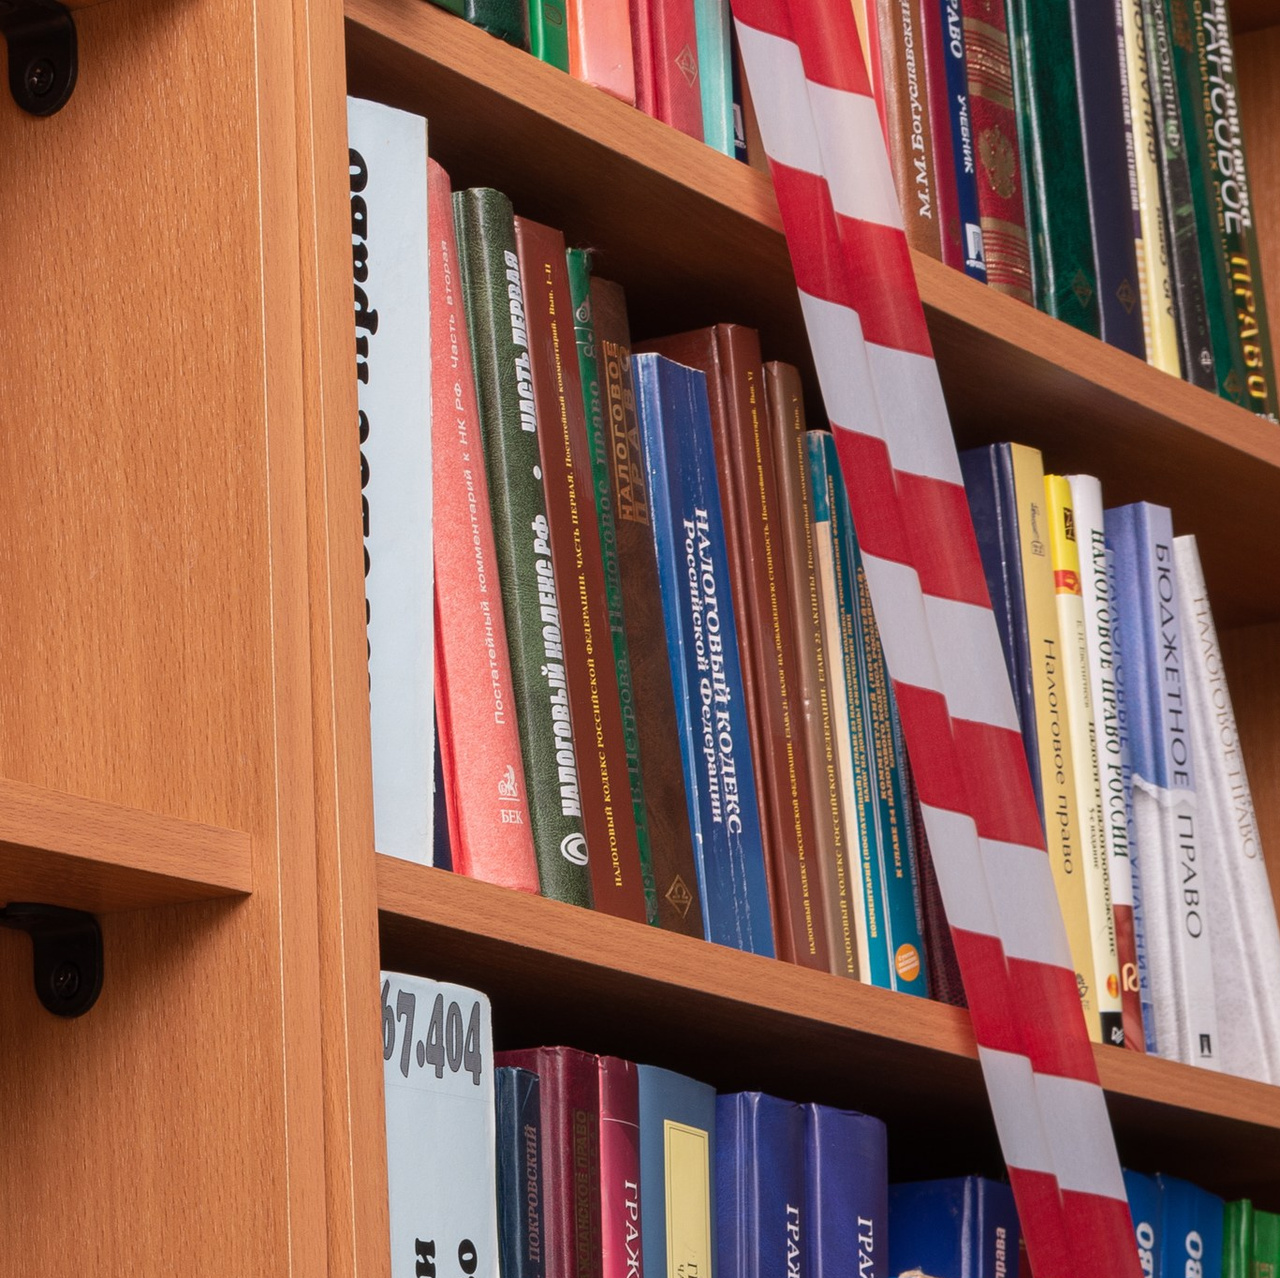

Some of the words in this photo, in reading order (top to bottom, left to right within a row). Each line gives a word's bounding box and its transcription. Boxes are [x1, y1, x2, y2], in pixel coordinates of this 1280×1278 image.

[956, 94, 973, 173] УЧЕБНИК
[441, 240, 454, 306] вторая
[502, 249, 527, 346] ПЕРВАЯ
[443, 314, 459, 369] Часть
[1230, 256, 1268, 399] ПРАВО
[453, 378, 465, 412] РФ.
[456, 417, 468, 445] НК
[514, 352, 537, 433] ЧАСТЬ
[559, 396, 573, 468] Постатейный
[586, 378, 607, 466] право
[604, 341, 635, 520] НАЛОГОВОЕ
[618, 345, 647, 525] ПРАВО
[459, 452, 470, 462] к
[567, 471, 579, 525] ПЕРВАЯ.
[461, 469, 487, 593] комментарий
[530, 514, 552, 557] РФ
[573, 528, 584, 569] ЧАСТЬ
[535, 559, 563, 660] КОДЕКС
[578, 572, 593, 655] ФЕДЕРАЦИИ.
[1091, 528, 1114, 669] НАЛОГОВОЕ
[476, 600, 506, 725] Постатейный
[586, 658, 605, 748] РОССИЙСКОЙ
[682, 518, 710, 672] Российской
[699, 677, 726, 824] Федерации
[693, 507, 732, 705] НАЛОГОВЫЙ
[715, 709, 742, 835] КОДЕКС
[542, 662, 582, 818] НАЛОГОВЫЙ
[1043, 639, 1065, 785] Налоговое
[1055, 794, 1073, 875] право
[1101, 677, 1121, 754] ПРАВО
[1155, 543, 1190, 788] БЮДЖЕТНОЕ
[1177, 814, 1202, 939] ПРАВО
[1192, 595, 1237, 762] НАЛОГОВОЕ
[1227, 769, 1257, 861] ПРАВО
[501, 809, 523, 825] БЕК
[598, 751, 612, 803] КОДЕКС
[1107, 762, 1128, 859] РОССИИ
[604, 806, 623, 887] НАЛОГОВЫЙ
[382, 979, 482, 1086] 67.404
[574, 1110, 588, 1166] ПРАВО
[523, 1123, 541, 1264] ПОКРОВСКИЙ
